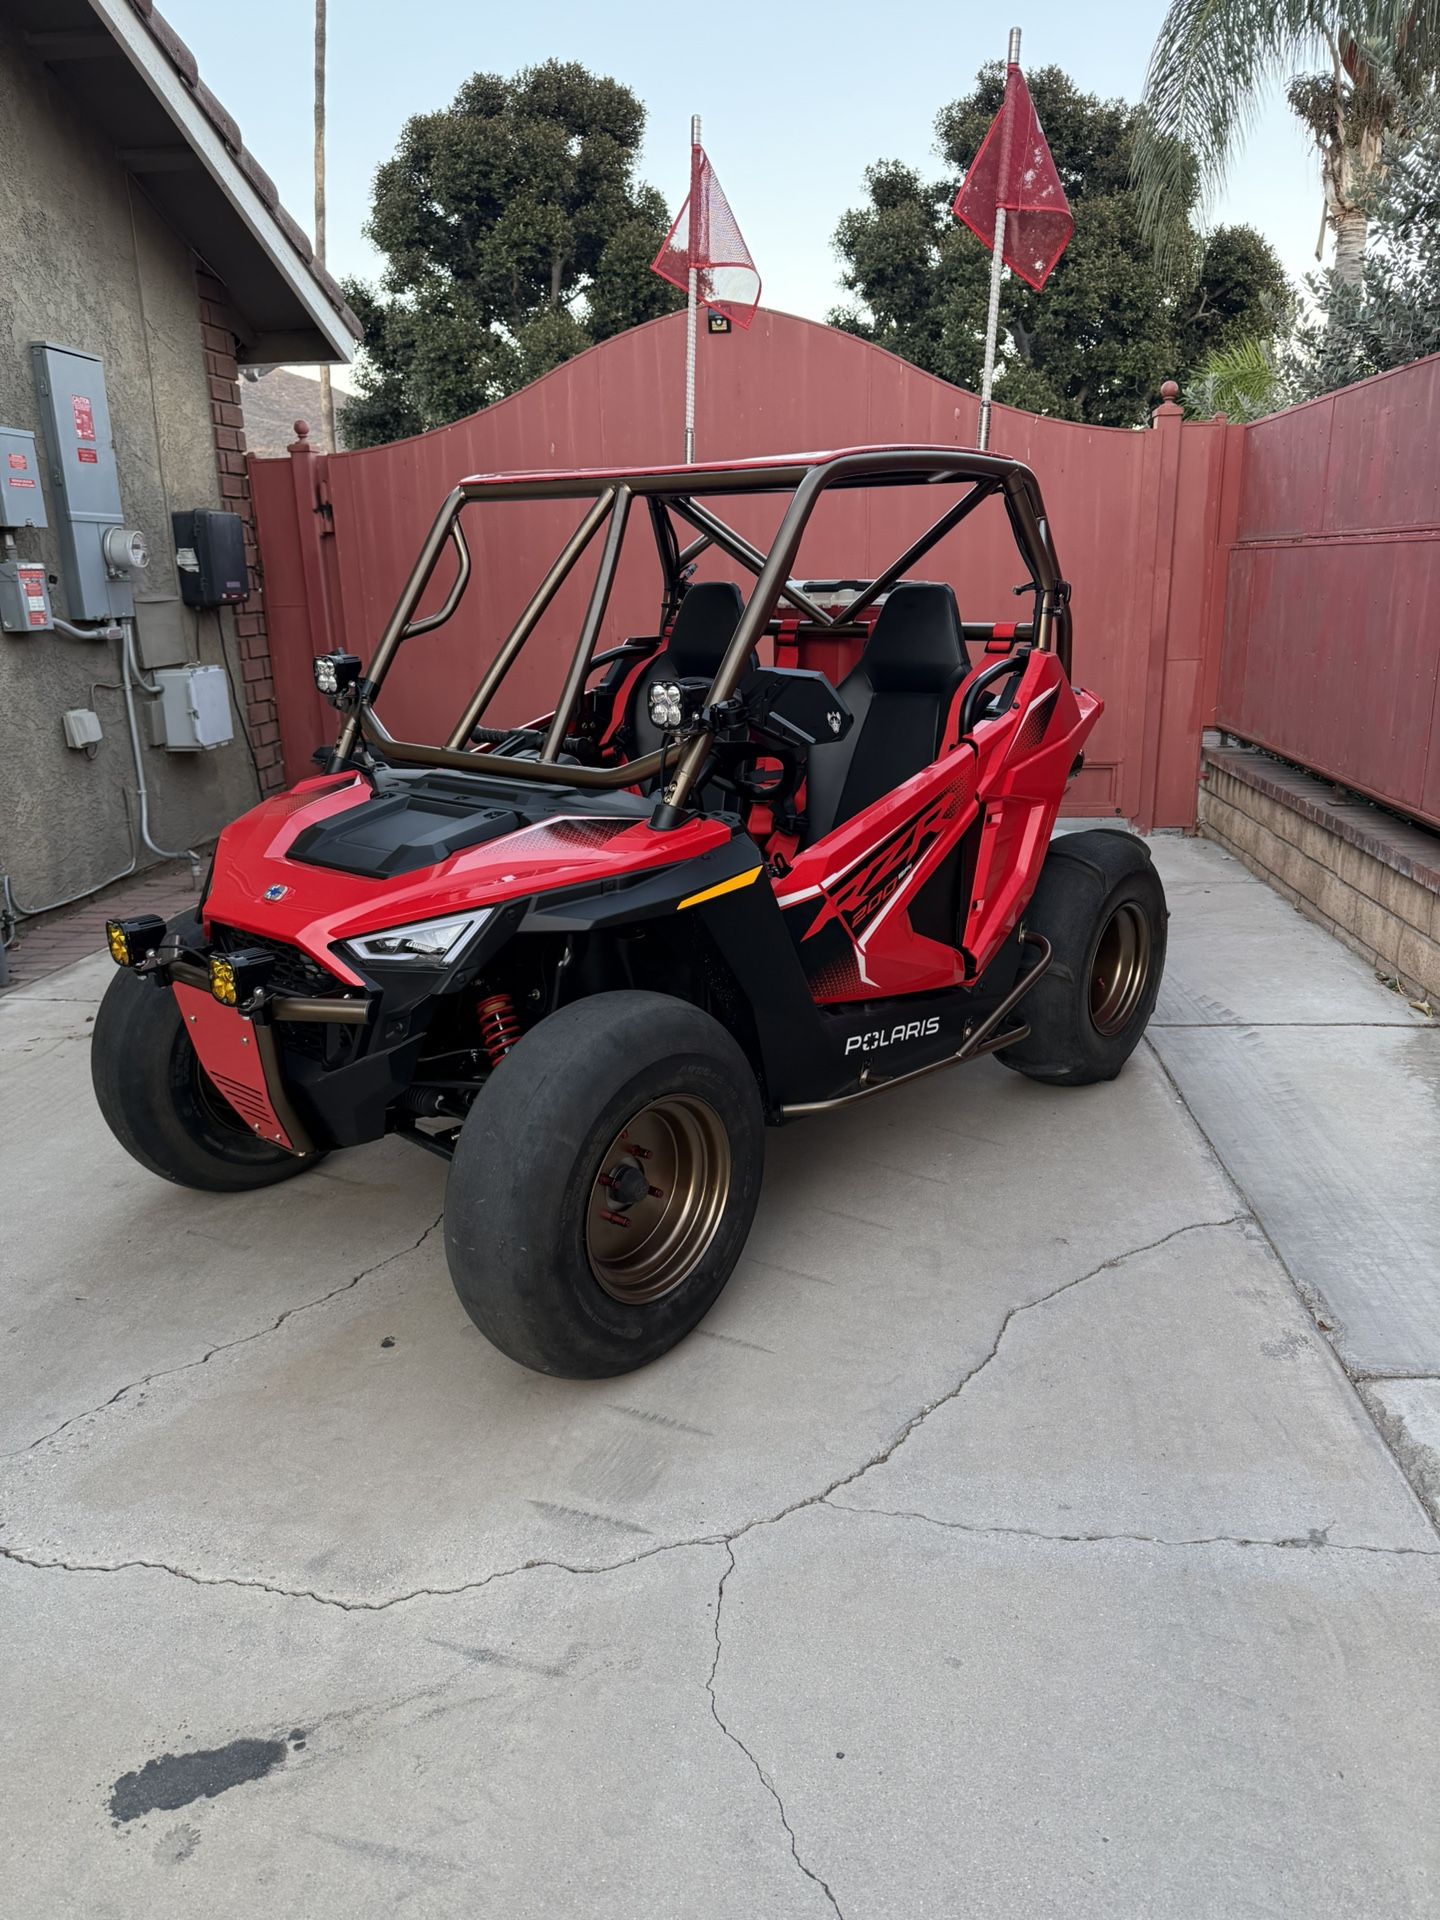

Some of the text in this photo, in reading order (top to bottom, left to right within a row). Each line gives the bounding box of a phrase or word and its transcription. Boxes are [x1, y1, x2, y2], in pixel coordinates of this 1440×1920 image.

[801, 792, 956, 943] RZR
[851, 877, 898, 929] 200
[844, 1016, 940, 1056] POLARIS
